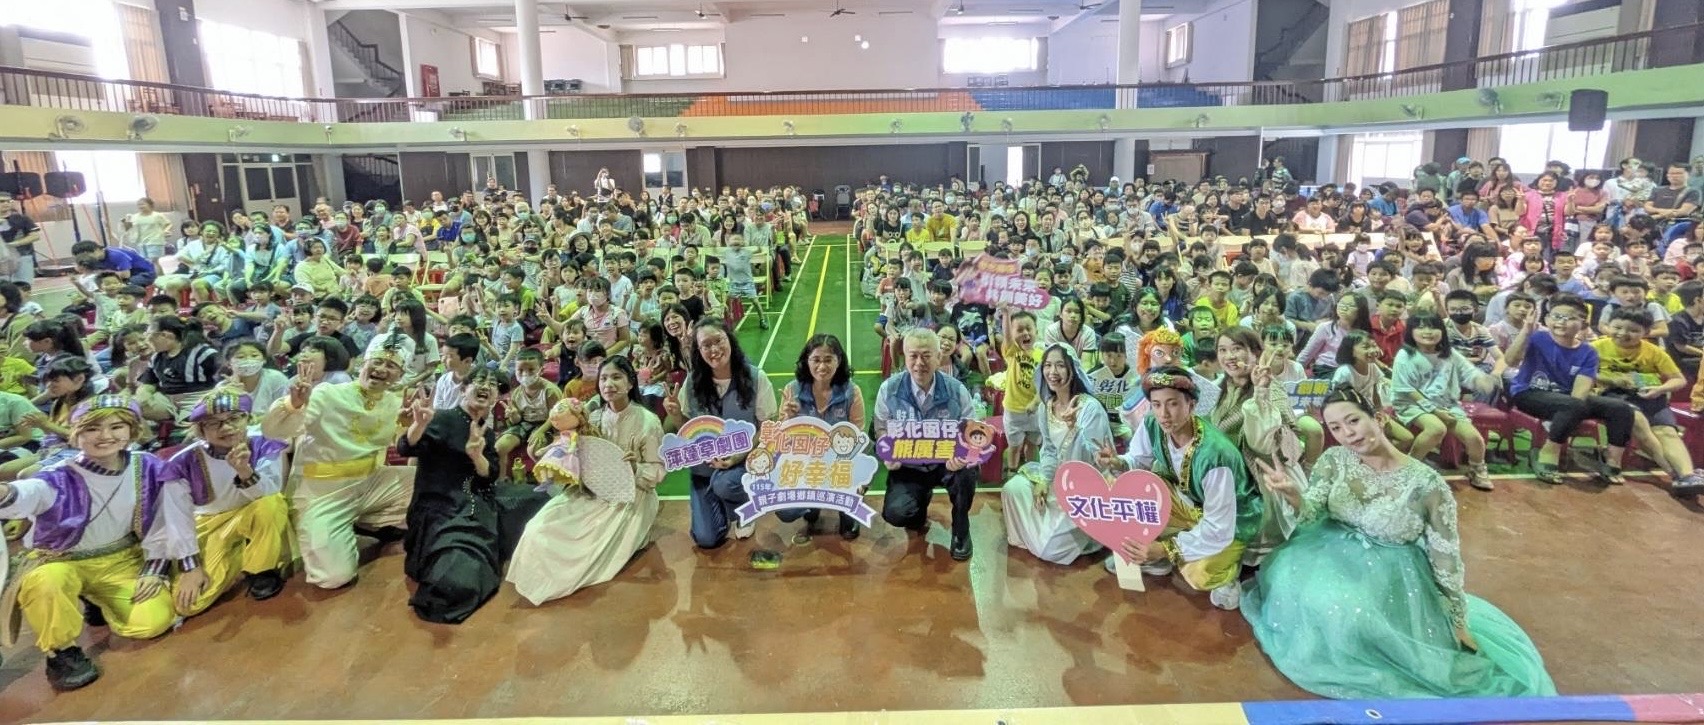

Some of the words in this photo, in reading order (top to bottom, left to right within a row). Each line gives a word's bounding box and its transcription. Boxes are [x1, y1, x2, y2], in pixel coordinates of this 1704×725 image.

[779, 460, 853, 488] 好幸福
[1066, 496, 1161, 525] 文化平權
